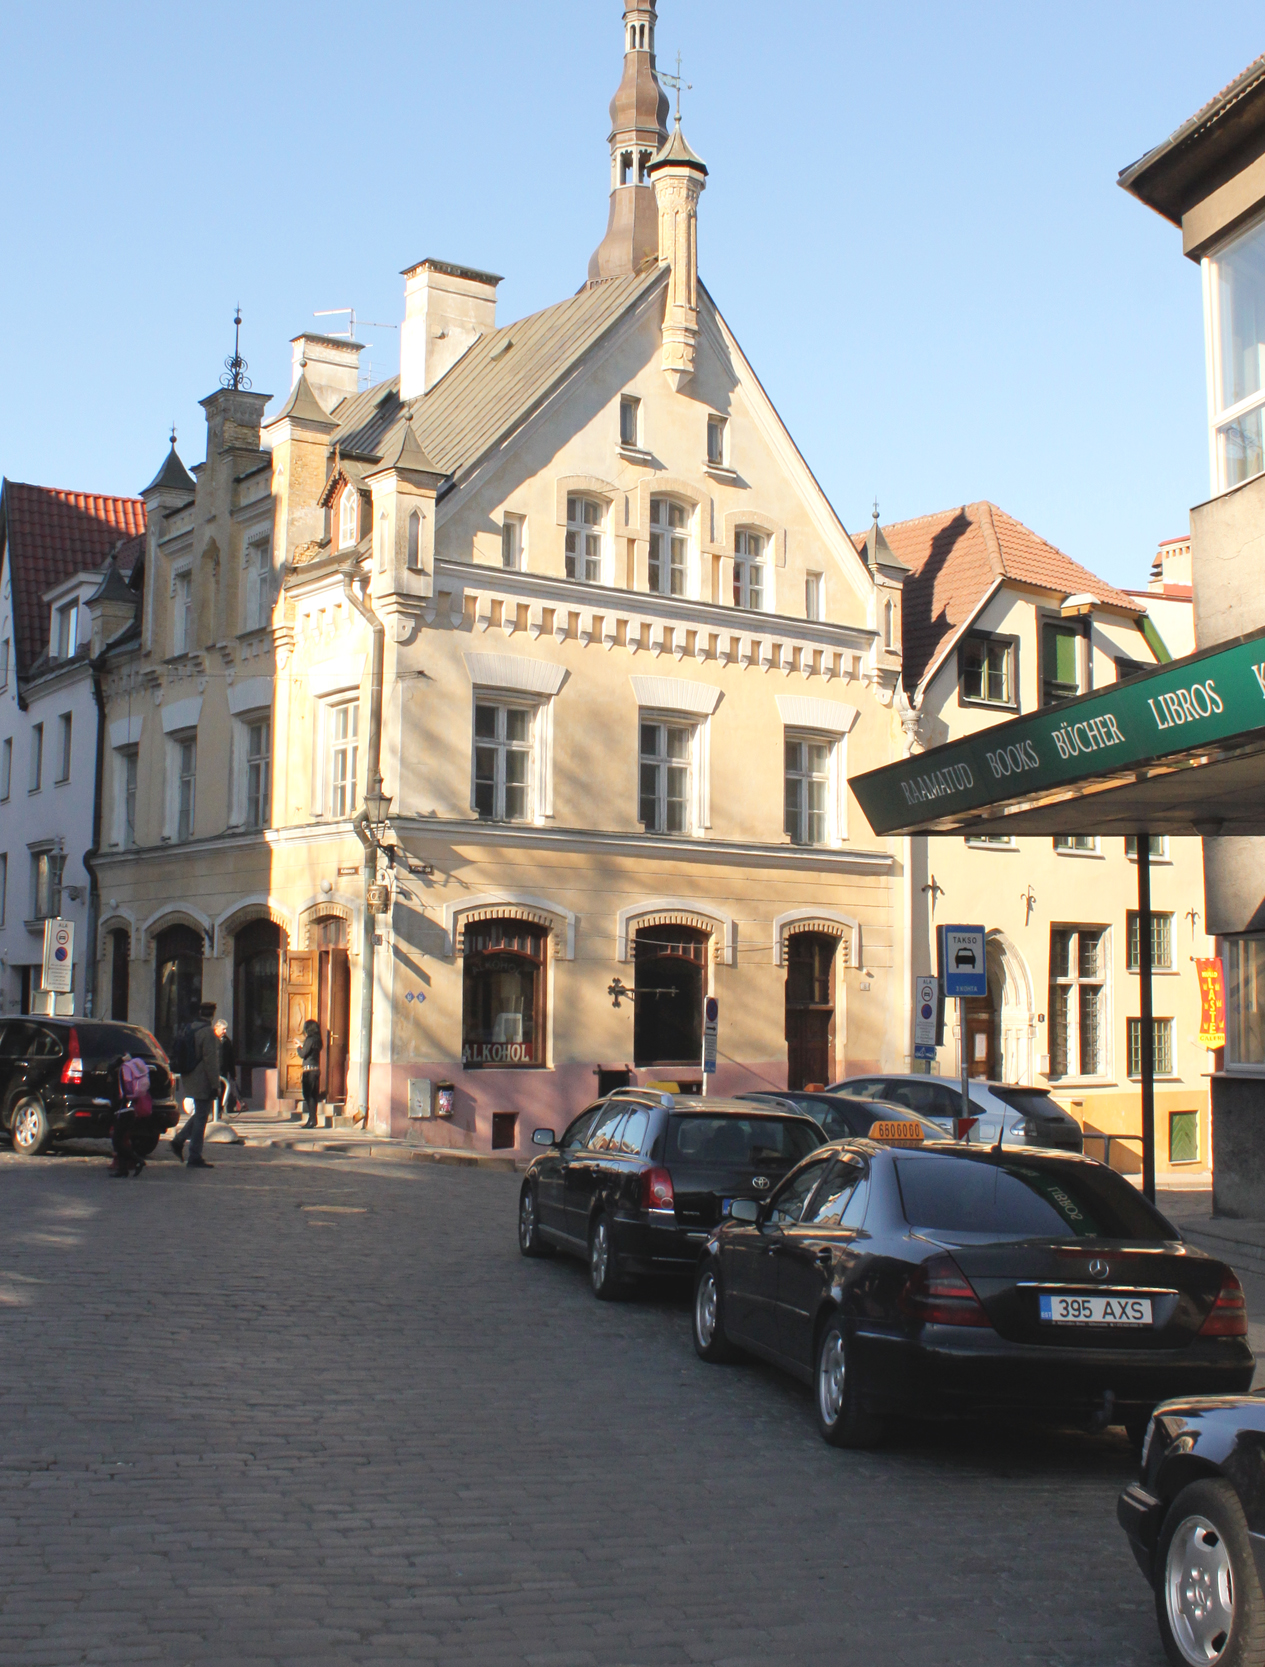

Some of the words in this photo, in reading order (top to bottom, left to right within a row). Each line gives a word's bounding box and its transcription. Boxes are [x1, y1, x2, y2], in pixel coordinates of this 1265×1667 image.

[1147, 678, 1224, 730] LIBROS
[1051, 713, 1126, 760] BÜCHER
[985, 739, 1040, 779] BOOKS
[900, 762, 975, 806] RAAMATUD
[953, 936, 977, 944] TAKSO
[471, 960, 522, 977] ALKOHOL
[1207, 977, 1217, 1034] LASTE
[462, 1044, 530, 1062] ALKOHOL
[1058, 1298, 1093, 1319] 395
[1101, 1299, 1144, 1320] AXS
